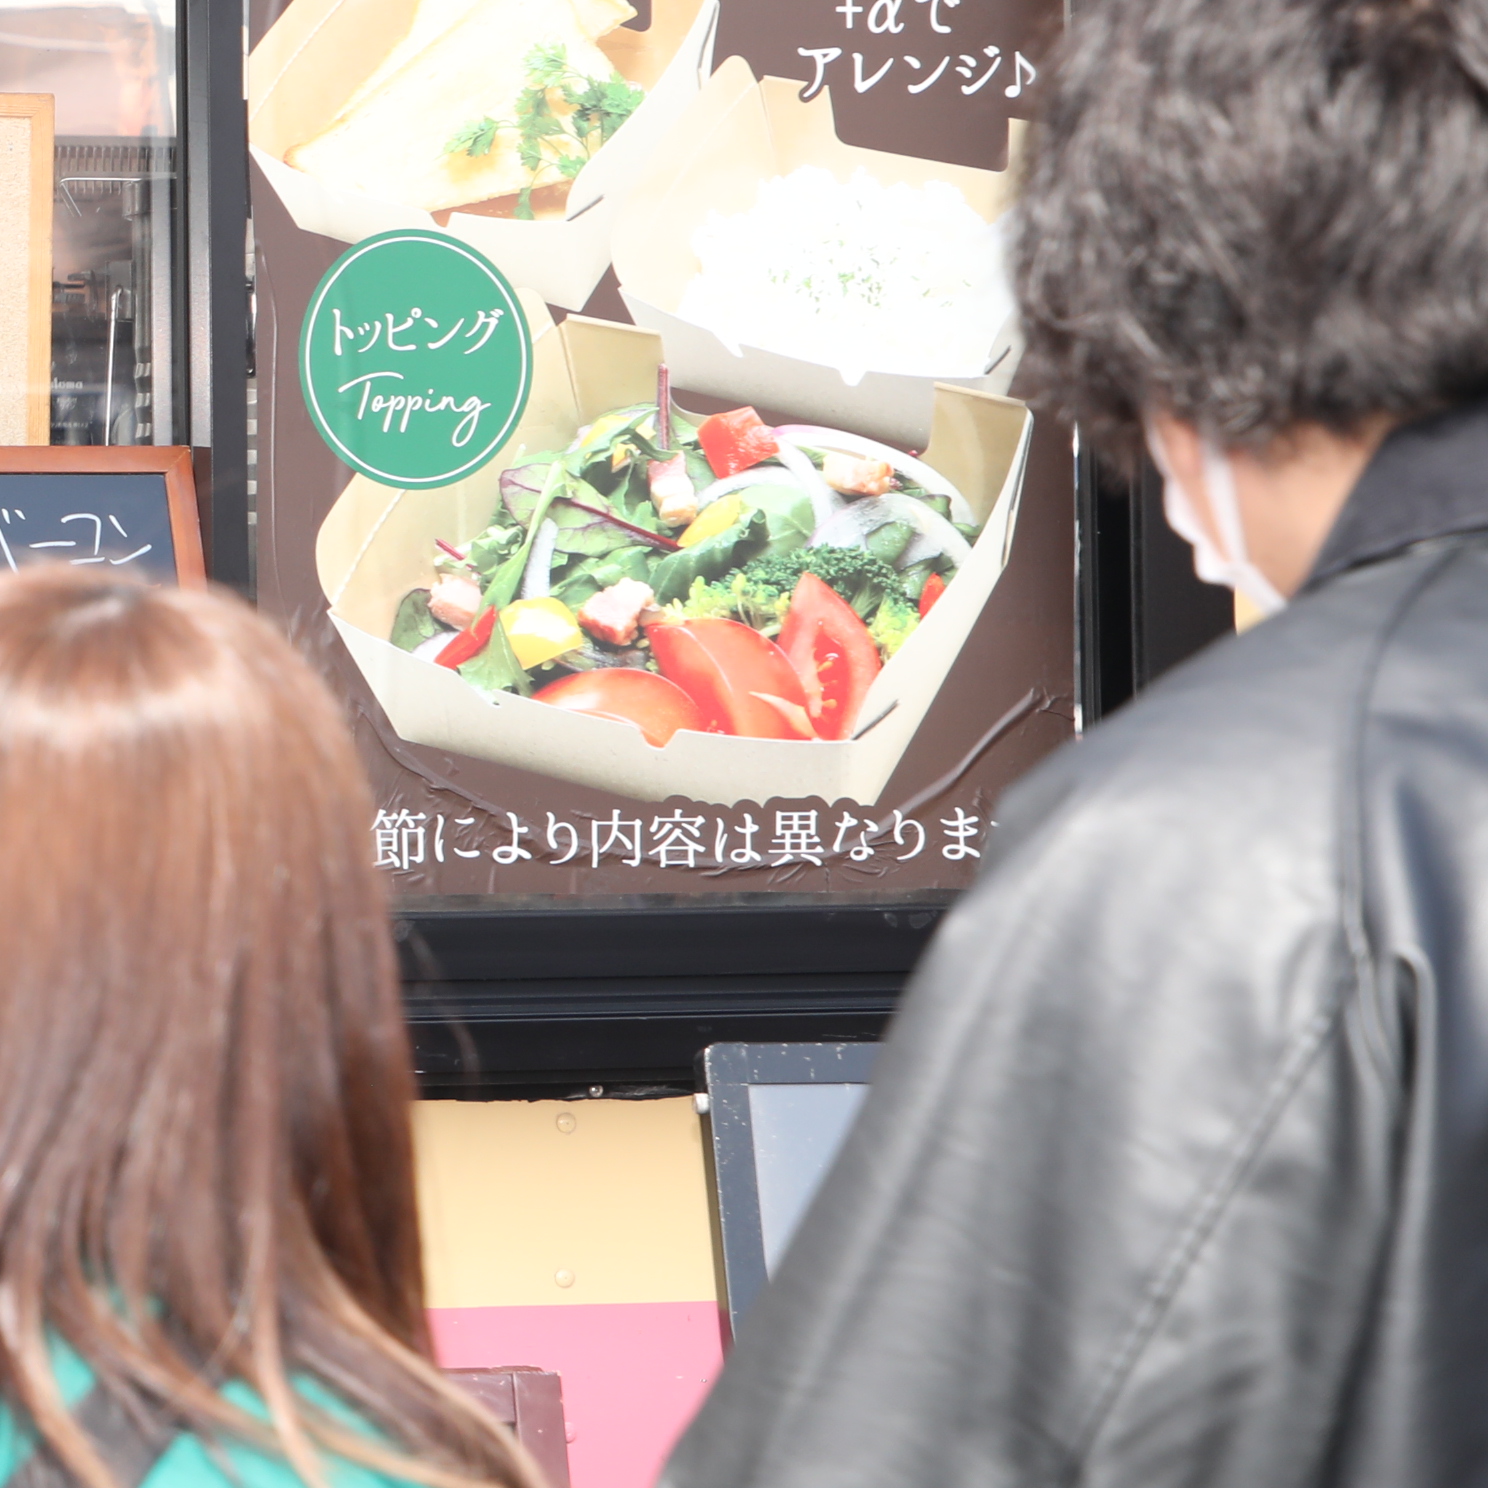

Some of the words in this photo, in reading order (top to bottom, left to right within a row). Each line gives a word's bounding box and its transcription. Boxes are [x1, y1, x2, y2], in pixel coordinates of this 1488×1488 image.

[331, 305, 506, 357] トッピング
[337, 371, 492, 447] Topping
[369, 807, 1000, 870] 節により内容は異なりま
